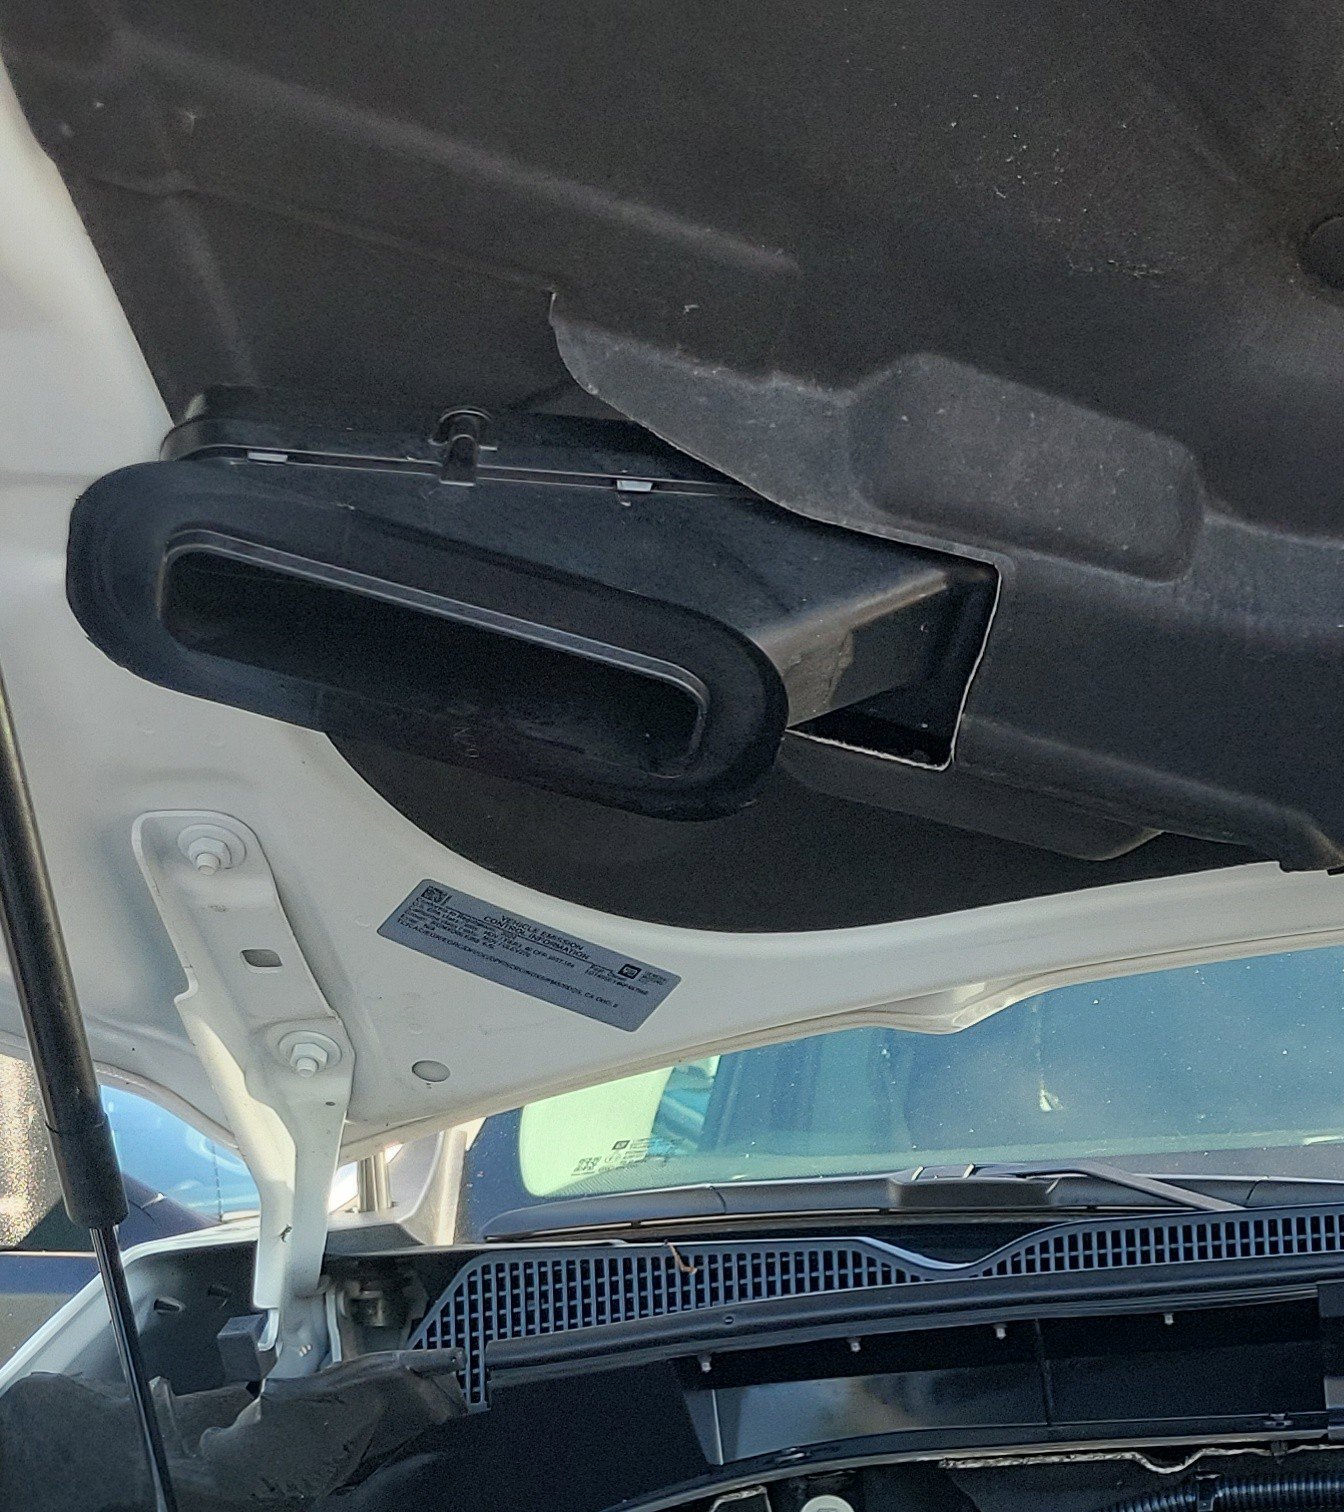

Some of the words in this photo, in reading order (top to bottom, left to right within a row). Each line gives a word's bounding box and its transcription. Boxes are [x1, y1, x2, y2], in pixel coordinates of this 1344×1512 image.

[482, 915, 528, 936] CONTROL
[527, 932, 591, 960] INFORMATION
[499, 914, 540, 934] VEHICLE
[539, 929, 585, 951] EMISSION
